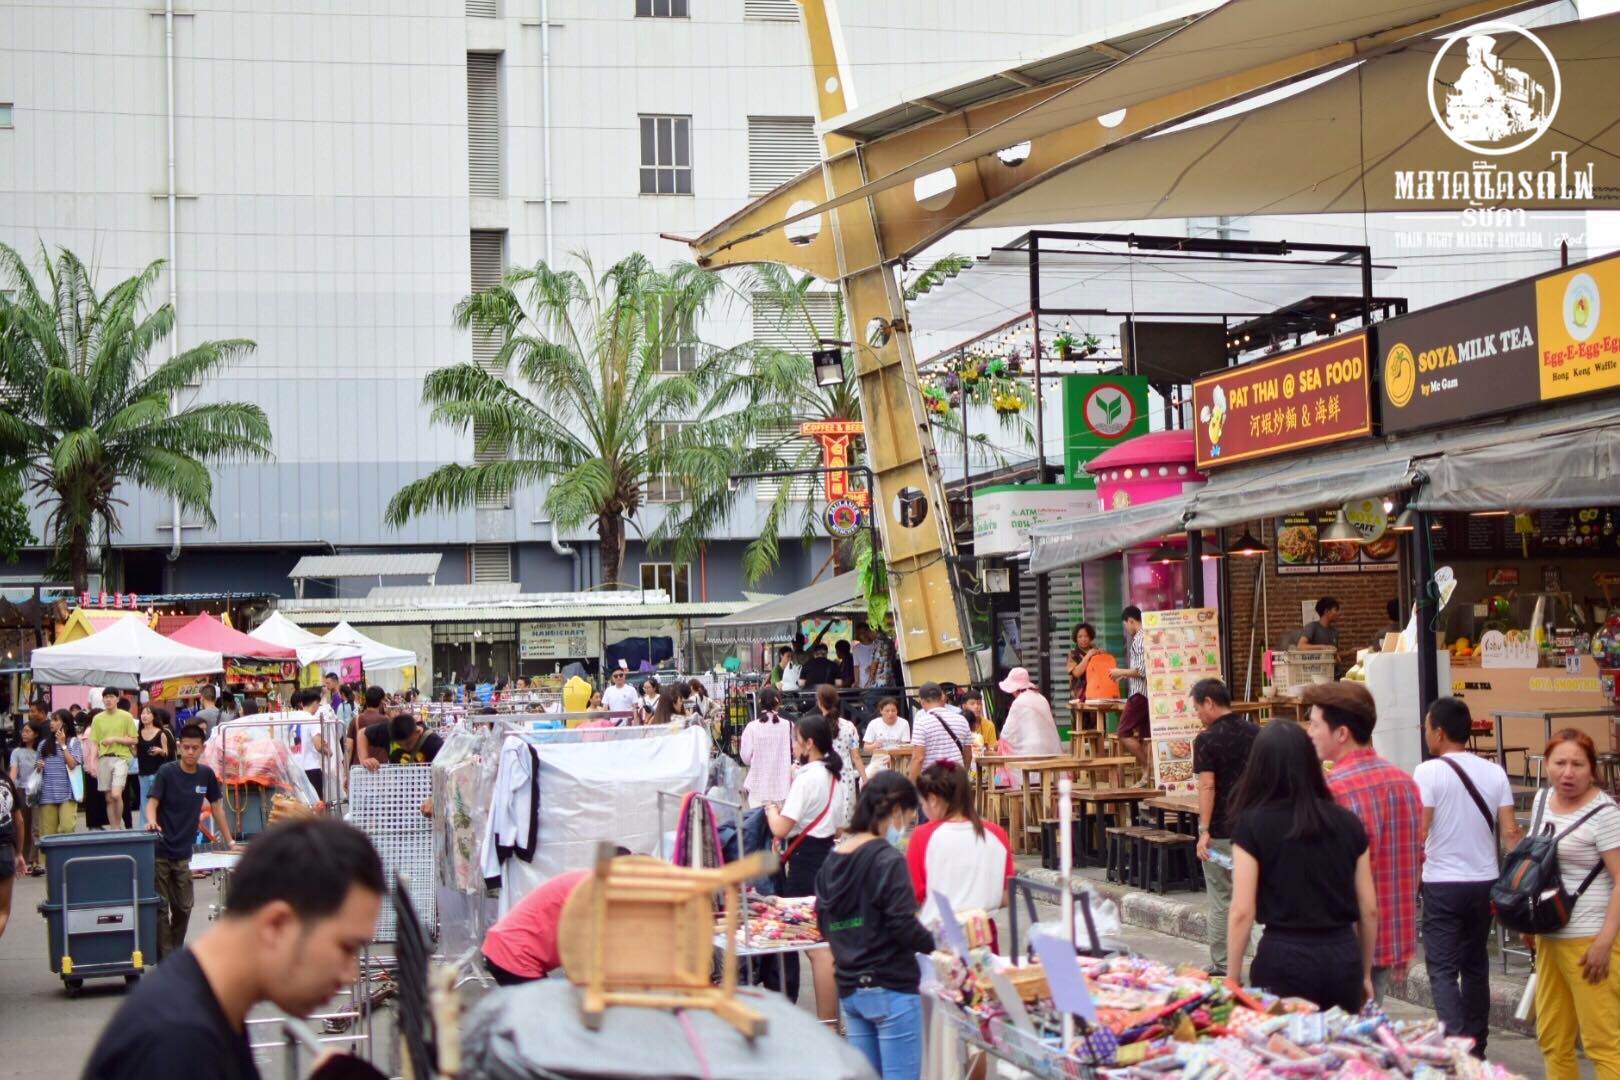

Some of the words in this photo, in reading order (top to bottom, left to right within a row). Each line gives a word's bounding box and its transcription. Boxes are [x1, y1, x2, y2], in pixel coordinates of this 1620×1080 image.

[1499, 325, 1534, 353] TEA
[1552, 372, 1569, 381] Hong
[1594, 360, 1617, 372] Waffle
[1229, 386, 1249, 410] PAT
[1252, 378, 1279, 404] THAI
[1283, 373, 1295, 399] @
[1300, 367, 1322, 393] SEA
[1326, 357, 1362, 386] FOOD
[1421, 383, 1430, 396] by
[1430, 381, 1440, 393] Mc
[1301, 404, 1311, 428] &
[1315, 394, 1341, 425] 海鮮
[1019, 508, 1038, 516] ATM
